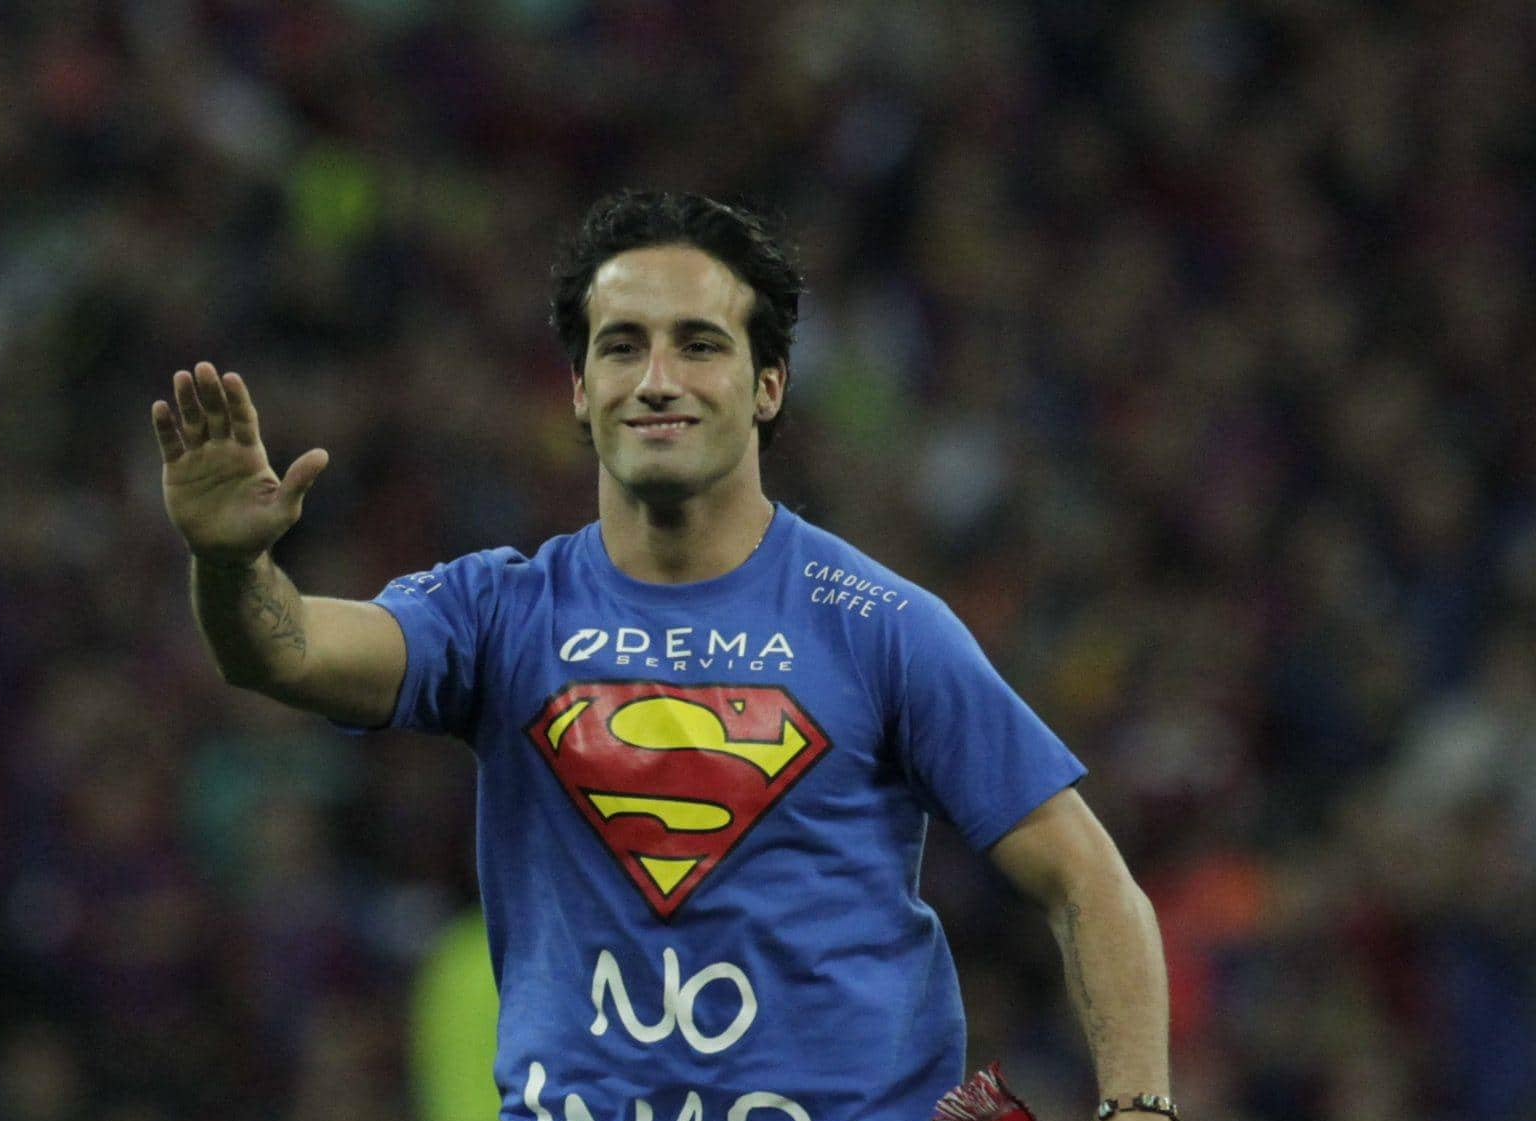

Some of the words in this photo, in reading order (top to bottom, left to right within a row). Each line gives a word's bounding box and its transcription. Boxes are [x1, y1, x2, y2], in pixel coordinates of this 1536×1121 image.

[803, 560, 909, 611] CARDUCCI
[810, 586, 876, 618] CAFFE
[615, 655, 793, 672] SERVICE
[589, 946, 758, 1054] NO
